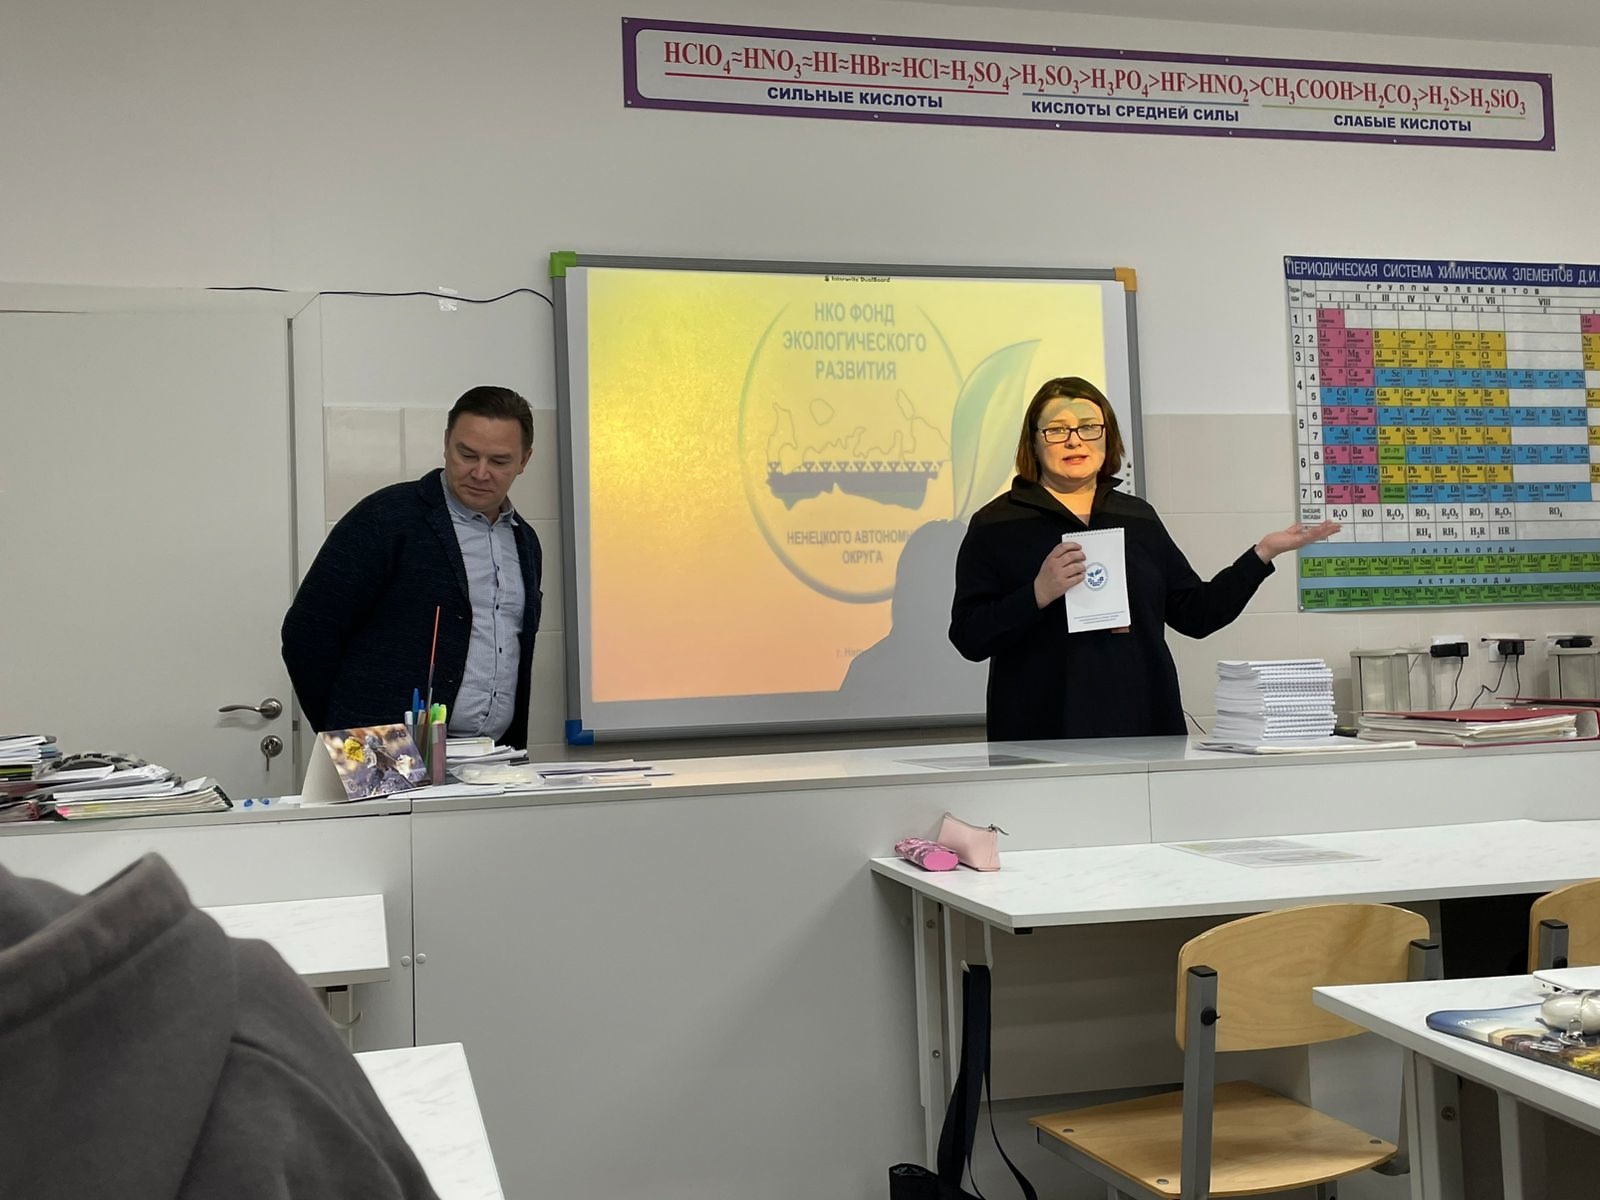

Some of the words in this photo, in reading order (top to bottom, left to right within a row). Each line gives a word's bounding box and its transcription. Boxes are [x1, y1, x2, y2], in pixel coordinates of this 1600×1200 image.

[767, 86, 854, 103] СИЛЬНЫЕ
[859, 92, 943, 108] КИСЛОТЫ
[1031, 100, 1111, 116] КИСЛОТЫ
[1115, 104, 1188, 121] СРЕДНЕЙ
[1193, 108, 1239, 122] СИЛЫ
[1333, 114, 1396, 129] СЛАБЫЕ
[1400, 117, 1472, 132] КИСЛОТЫ
[1286, 260, 1378, 278] ПЕРИОДИЧЕСКАЯ
[1383, 262, 1433, 278] СИСТЕМА
[1437, 264, 1508, 281] ХИМИЧЕСКИХ
[1512, 266, 1573, 283] ЭЛЕМЕНТОВ
[814, 302, 846, 322] НКО
[850, 302, 896, 327] ФОНД
[1293, 314, 1298, 324] 1
[1307, 314, 1312, 322] 1
[783, 330, 927, 353] ЭКОЛОГИЧЕСКОГО
[1294, 334, 1300, 344] 2
[1308, 334, 1314, 343] 2
[1295, 351, 1301, 361] 3
[1309, 354, 1314, 362] 3
[815, 360, 897, 381] РАЗВИТИЯ
[1297, 380, 1303, 390] 4
[1310, 373, 1315, 382] 4
[1311, 392, 1317, 401] 5
[1299, 419, 1305, 429] 5
[1312, 411, 1318, 420] 6
[1312, 431, 1318, 440] 7
[1300, 458, 1306, 468] 6
[1313, 451, 1319, 460] 8
[1314, 472, 1320, 480] 9
[1301, 488, 1307, 498] 7
[1313, 490, 1323, 498] 10
[1362, 508, 1374, 517] RO
[786, 530, 852, 545] НЕНЕЦКОГО
[1498, 526, 1510, 535] HR
[842, 550, 884, 564] ОКРУГА
